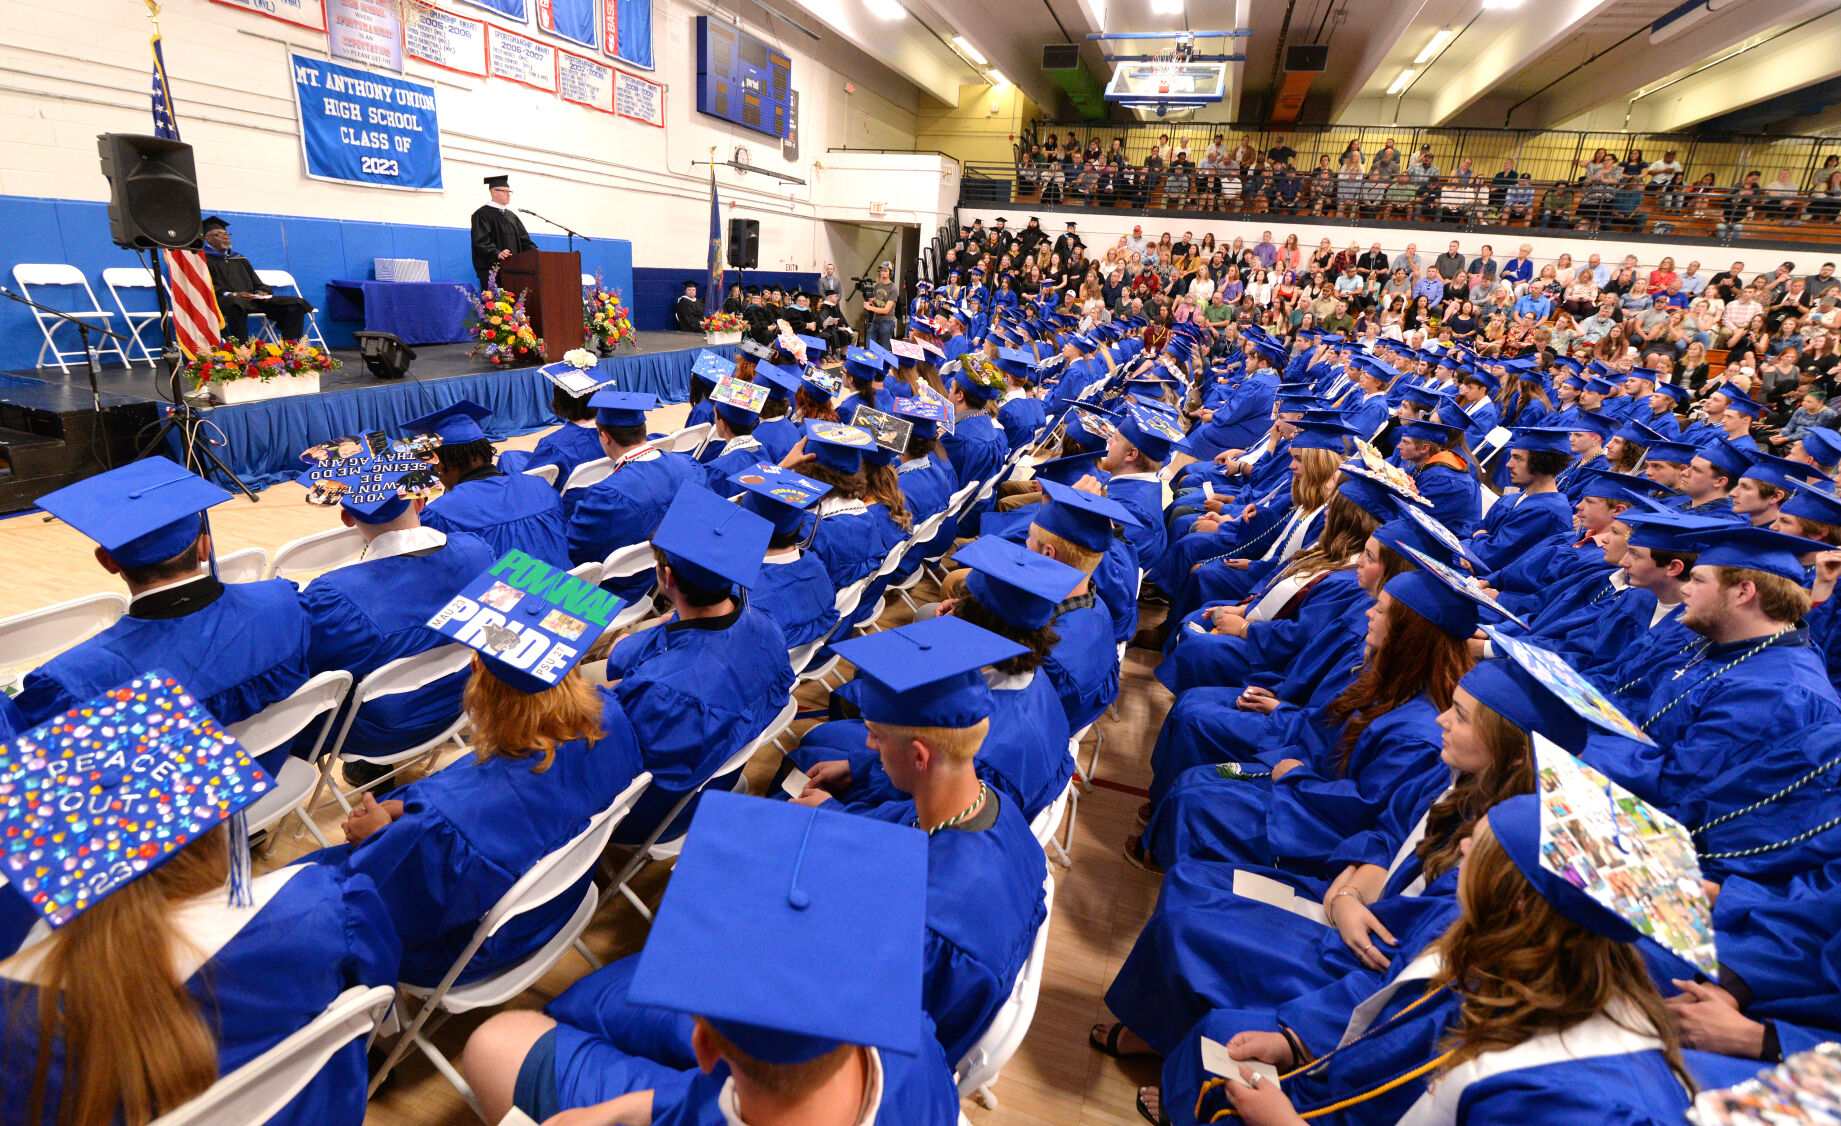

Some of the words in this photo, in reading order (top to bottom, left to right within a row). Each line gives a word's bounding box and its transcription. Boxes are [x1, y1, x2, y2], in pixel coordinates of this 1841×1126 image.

[295, 65, 321, 88] MT.
[325, 72, 393, 104] ANTHONY
[395, 88, 436, 112] UNION
[323, 97, 362, 121] HIGH
[368, 107, 423, 132] SCHOOL
[340, 126, 390, 151] CLASS
[394, 135, 412, 153] OF
[360, 156, 399, 176] 2023
[317, 457, 370, 468] AGAIN
[371, 462, 427, 473] SEEING
[374, 452, 415, 463] THAT
[310, 469, 333, 480] DO
[337, 466, 361, 477] ME
[360, 473, 384, 483] BE
[488, 548, 625, 627] POWNAL
[431, 608, 455, 626] MAU
[455, 599, 466, 613] 23
[426, 595, 578, 684] PRIDE
[536, 658, 555, 676] PSU
[553, 646, 566, 658] 27
[48, 750, 176, 783] PEACE
[59, 792, 142, 815] OUT
